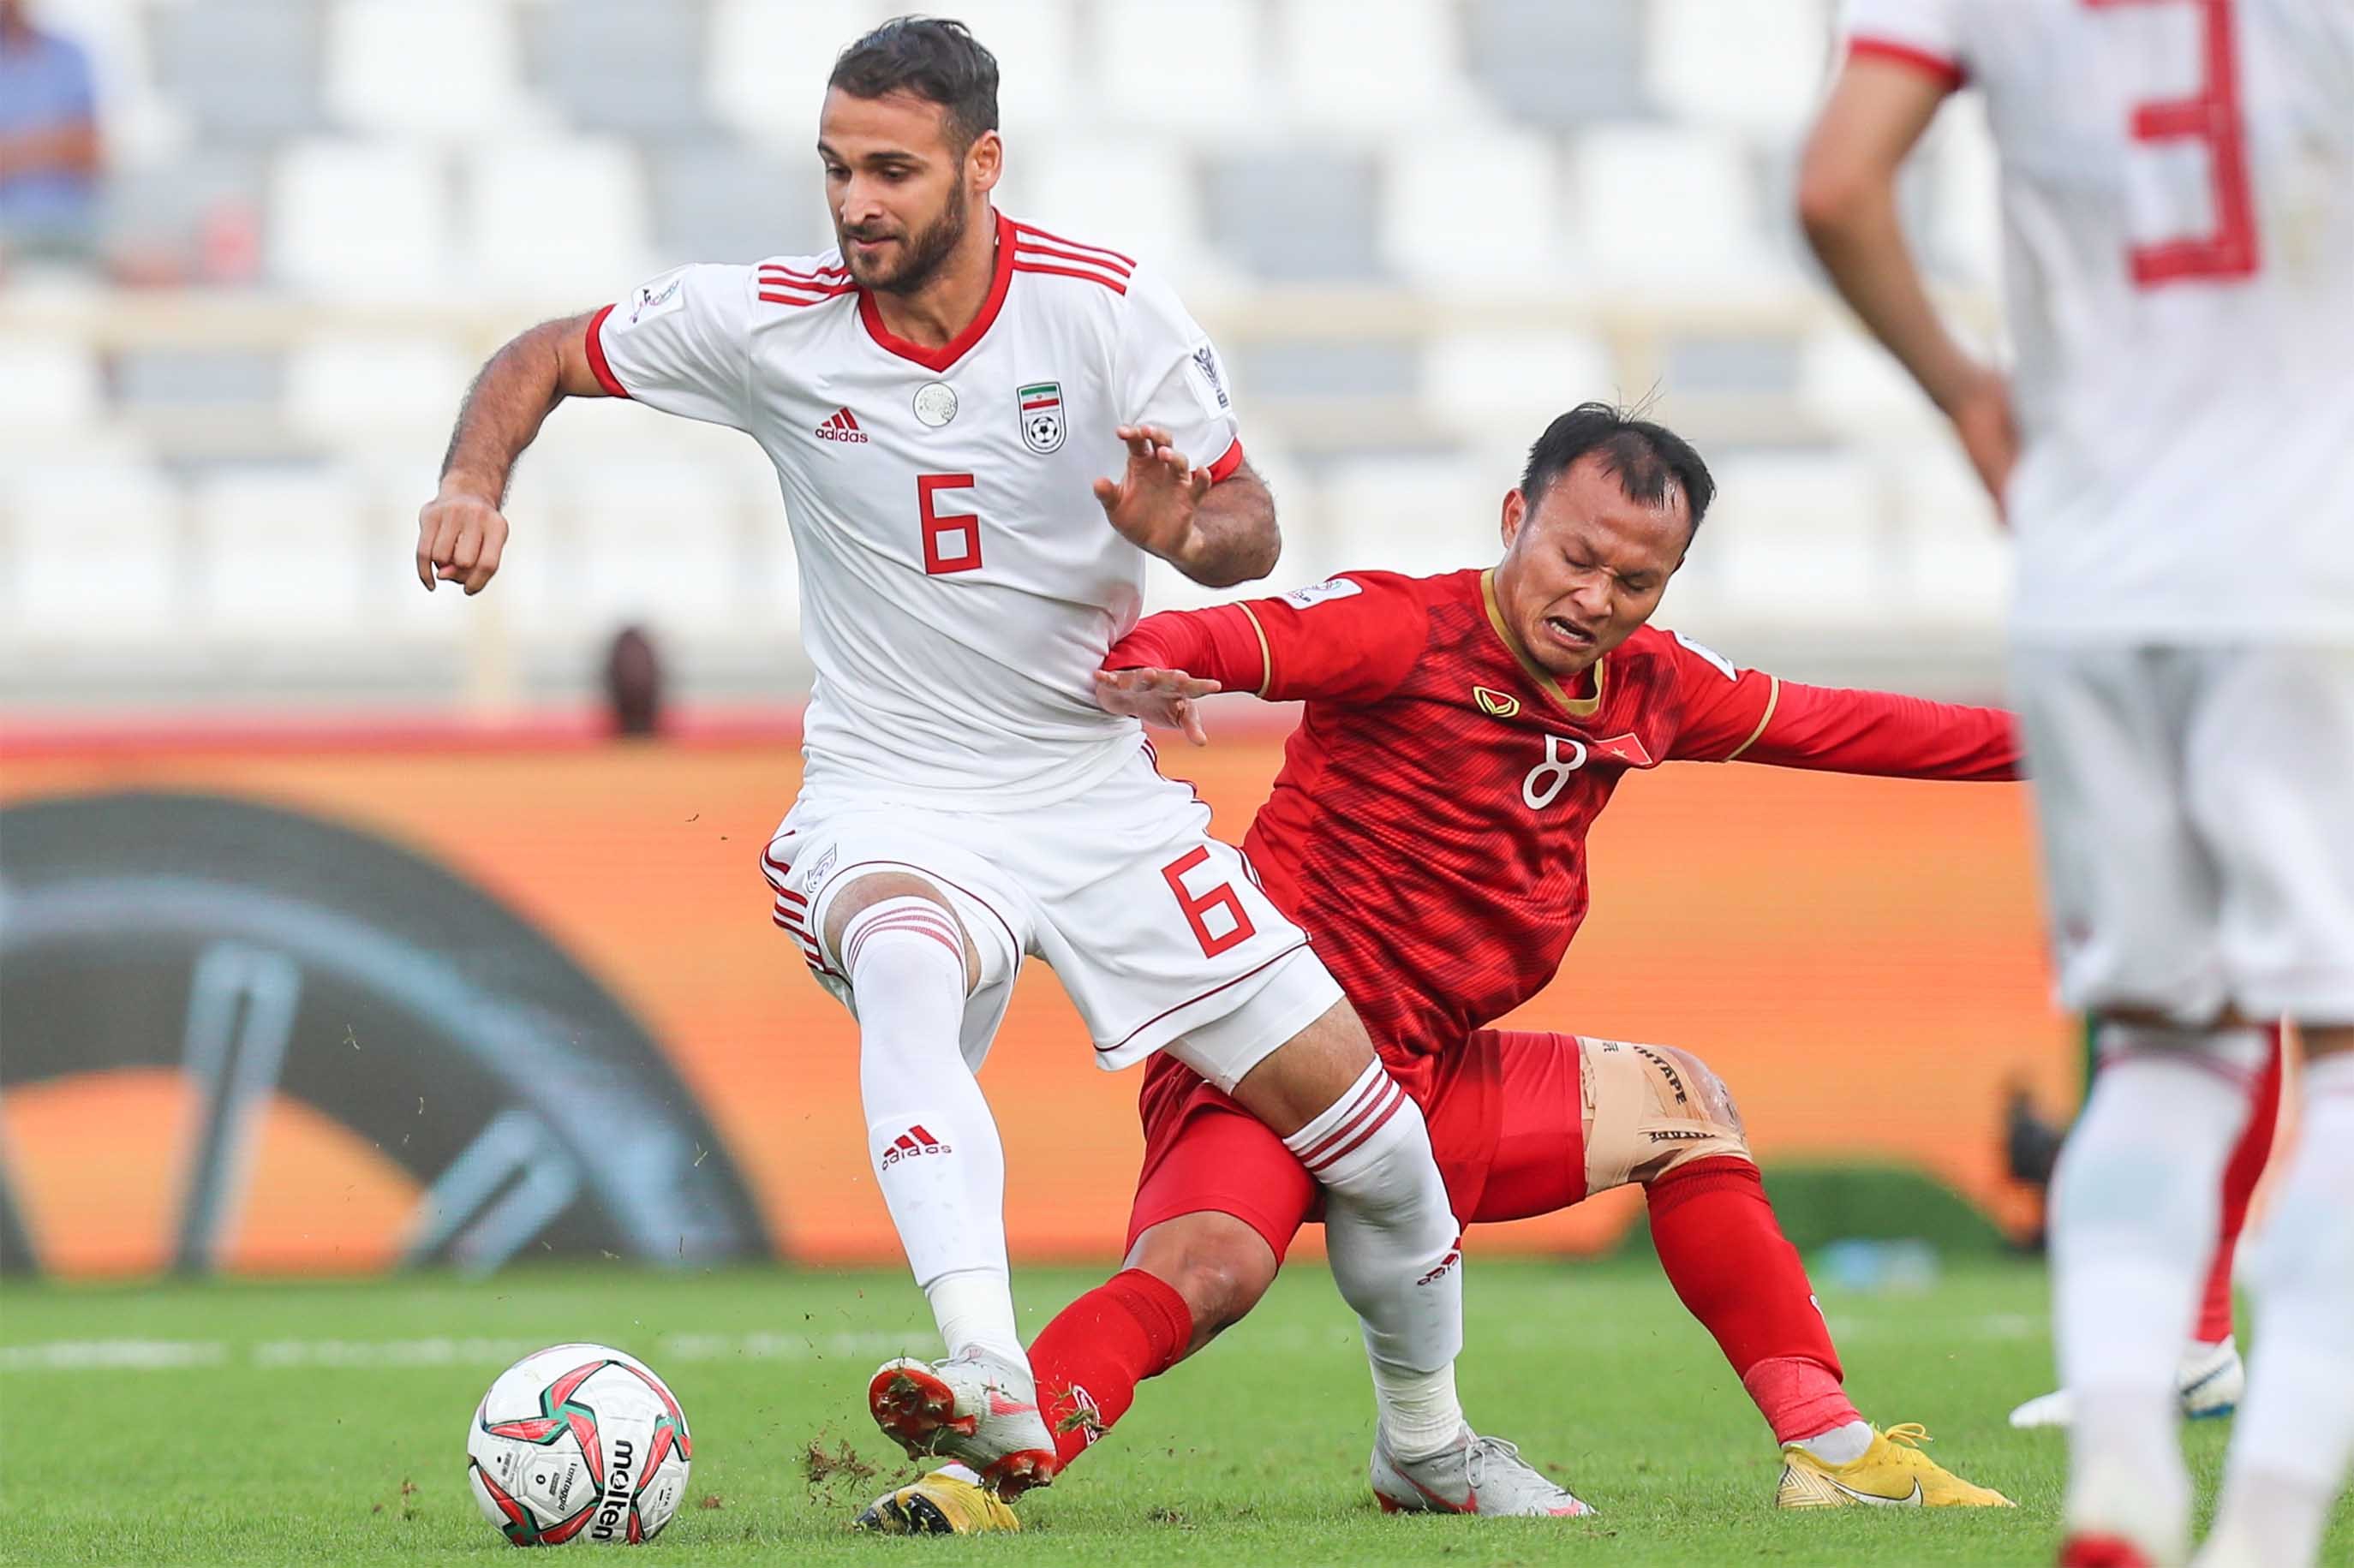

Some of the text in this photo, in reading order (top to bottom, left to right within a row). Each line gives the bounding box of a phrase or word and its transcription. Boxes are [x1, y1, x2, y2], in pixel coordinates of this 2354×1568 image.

[2076, 0, 2260, 289] 3
[816, 428, 868, 443] adidas
[917, 473, 983, 575] 6
[1522, 734, 1587, 810] 8
[1161, 844, 1257, 959] 6
[881, 1144, 953, 1172] adidas
[591, 1440, 633, 1540] molten
